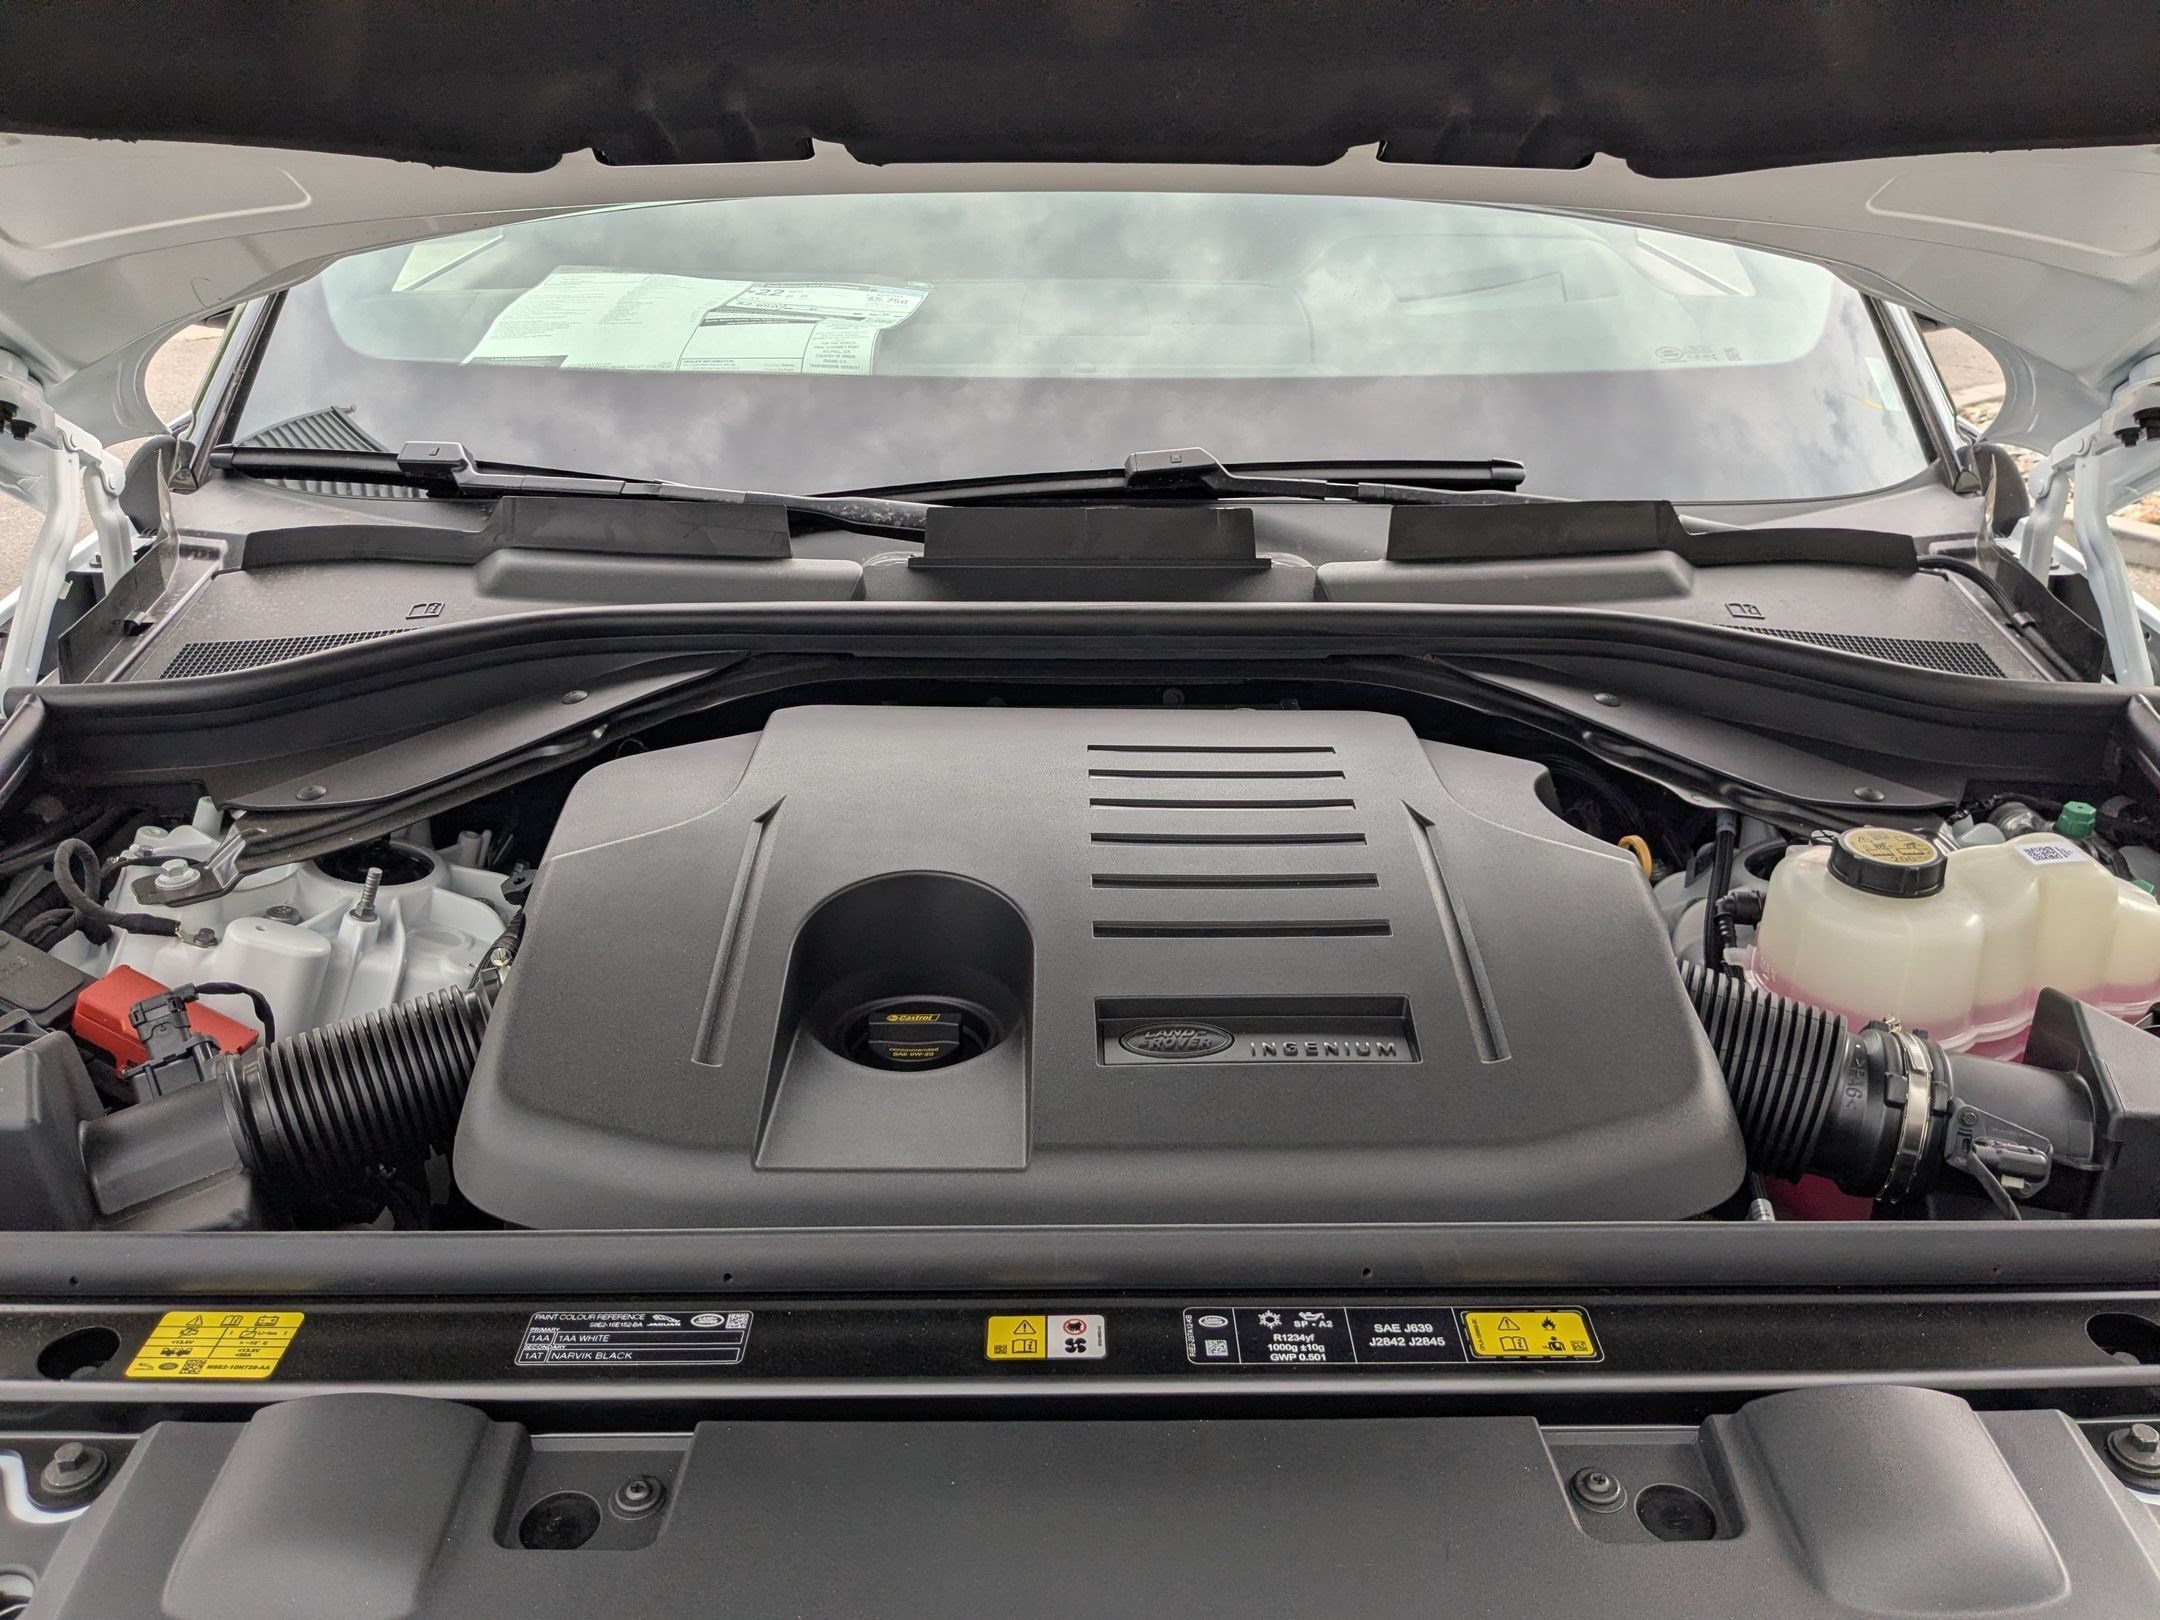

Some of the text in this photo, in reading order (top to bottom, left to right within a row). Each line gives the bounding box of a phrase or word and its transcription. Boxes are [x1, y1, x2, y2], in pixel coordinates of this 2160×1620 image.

[755, 288, 785, 297] 22
[898, 1014, 934, 1022] Castrol
[1144, 1028, 1197, 1038] LAND
[1145, 1036, 1213, 1050] ROVER
[1250, 1041, 1398, 1058] INGENIUM
[1293, 1320, 1308, 1328] SP
[1318, 1320, 1333, 1328] A2
[1374, 1323, 1434, 1333] SAE J639
[531, 1334, 610, 1342] 1AA 1AA WHITE
[1273, 1333, 1315, 1343] R1234yf
[1369, 1337, 1446, 1346] J2842 J2845
[1267, 1343, 1325, 1352] 1000g ±10g
[524, 1352, 633, 1360] 1AT NARVIK BLACK
[1270, 1353, 1326, 1362] GWP 0.501
